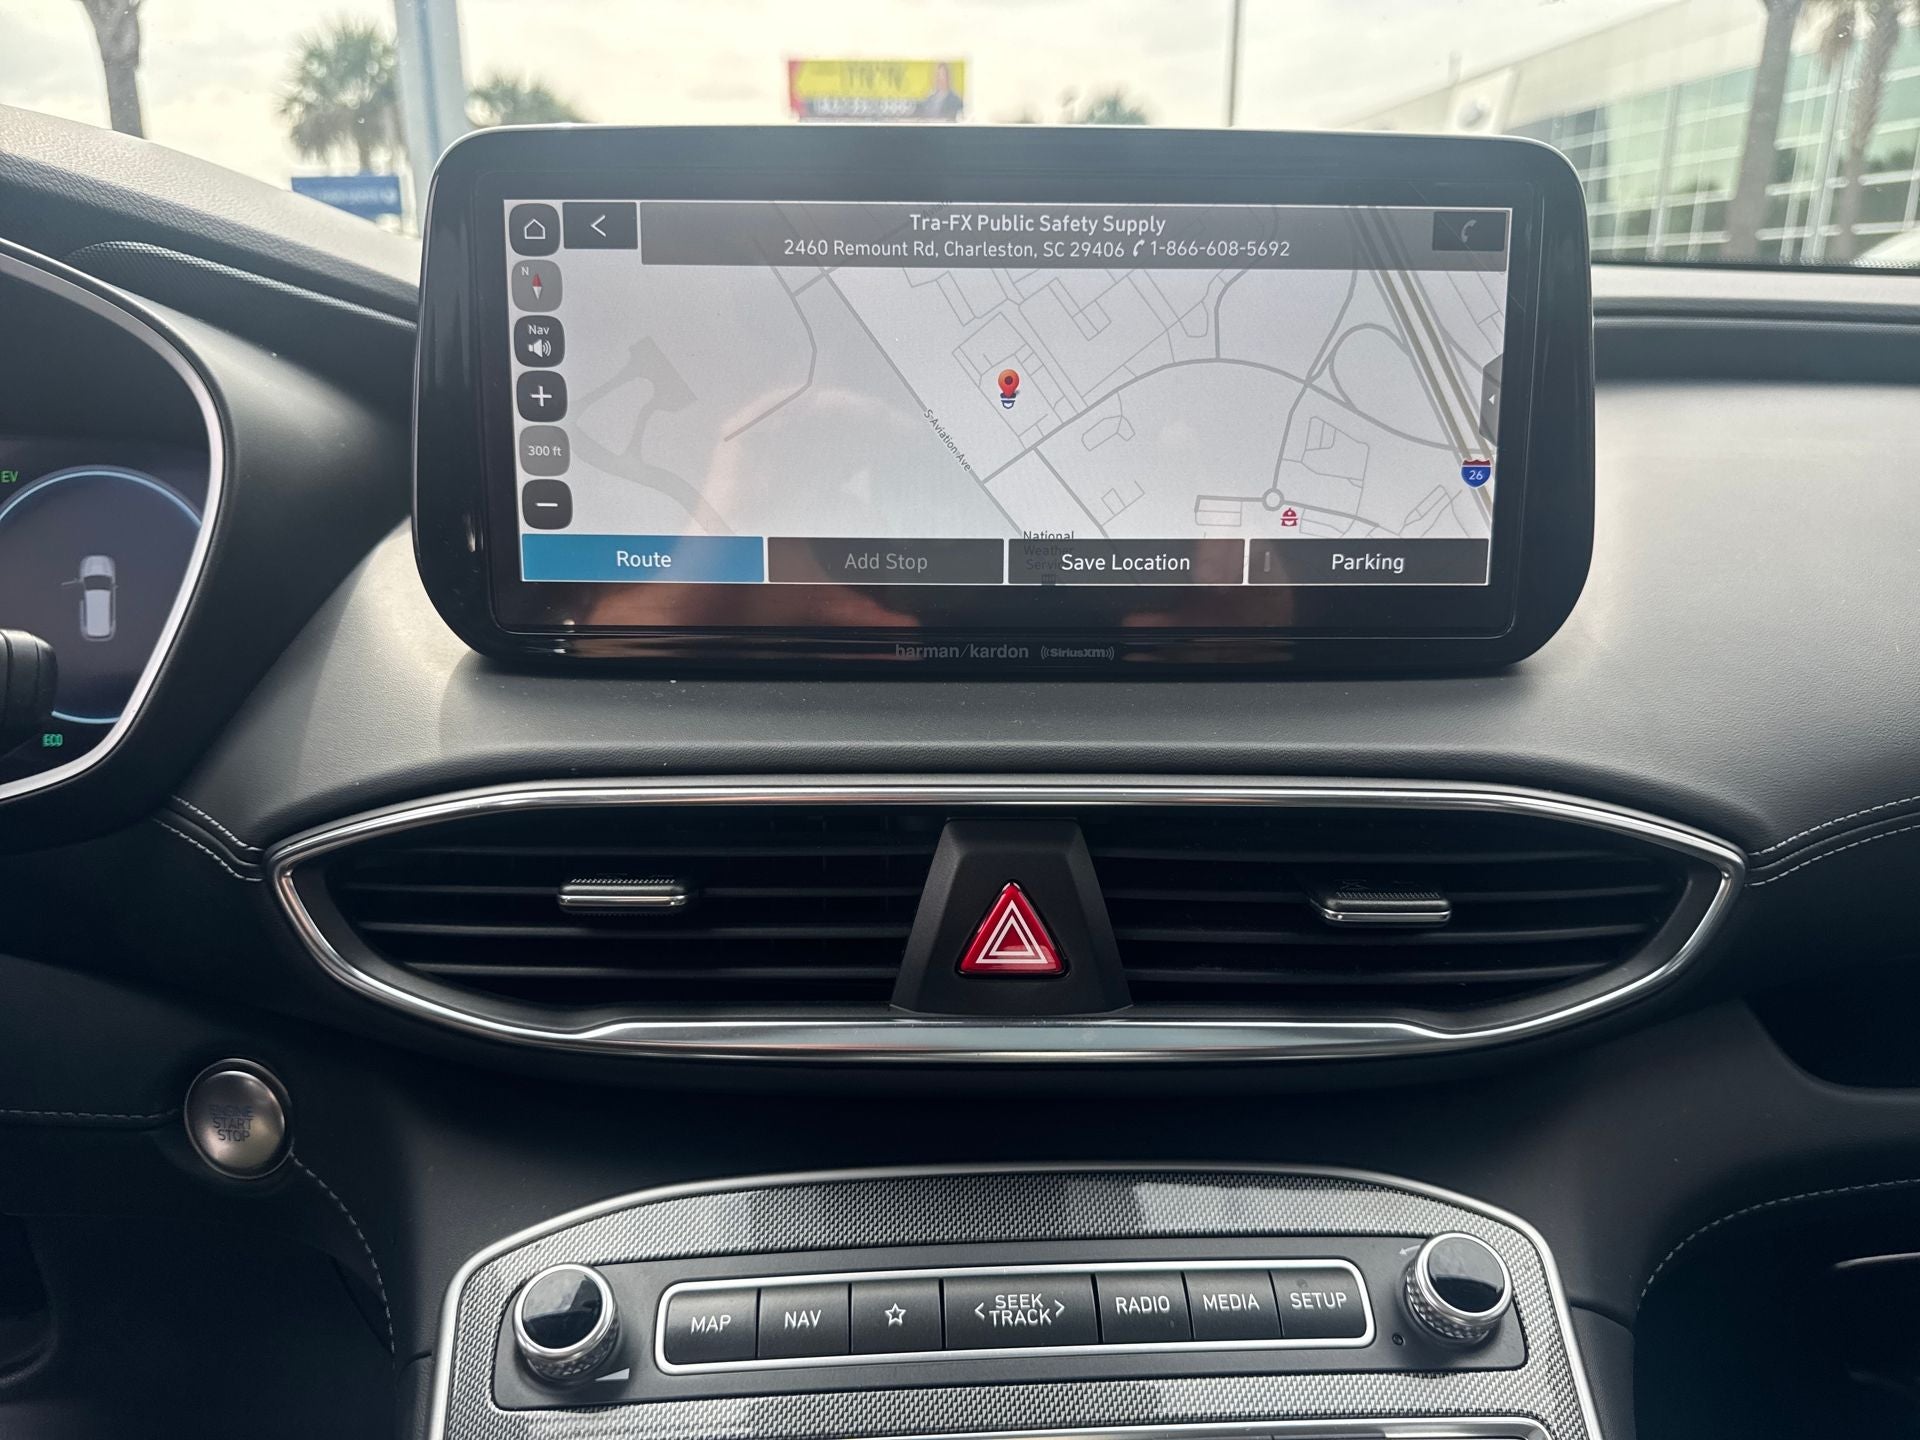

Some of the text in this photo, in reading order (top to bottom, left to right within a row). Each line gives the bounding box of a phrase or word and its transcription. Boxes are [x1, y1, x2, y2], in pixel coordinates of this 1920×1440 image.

[910, 214, 1166, 236] Tra-FX Public Safety Supply
[784, 240, 1290, 259] 2460 Remount Rd, Charleston, SC 29406 1-866-608-5692
[521, 266, 529, 276] N
[528, 324, 550, 335] Nav
[924, 409, 971, 471] S Aviation Ave
[528, 445, 562, 457] 300 ft
[1, 470, 19, 483] EV
[1469, 470, 1483, 481] 26
[1023, 531, 1074, 541] National
[617, 551, 672, 567] Route
[844, 553, 928, 573] Add Stop
[1061, 554, 1190, 571] Save Location
[1332, 553, 1405, 574] Parking
[43, 733, 63, 747] ECO
[213, 1117, 254, 1129] START
[217, 1128, 250, 1141] STOP
[995, 1293, 1044, 1309] SEEK
[1116, 1296, 1170, 1314] RADIO
[1203, 1293, 1260, 1311] MEDIA
[1290, 1292, 1347, 1310] SETUP
[691, 1315, 731, 1333] MAP
[785, 1310, 822, 1329] NAV
[989, 1308, 1052, 1327] TRACK
